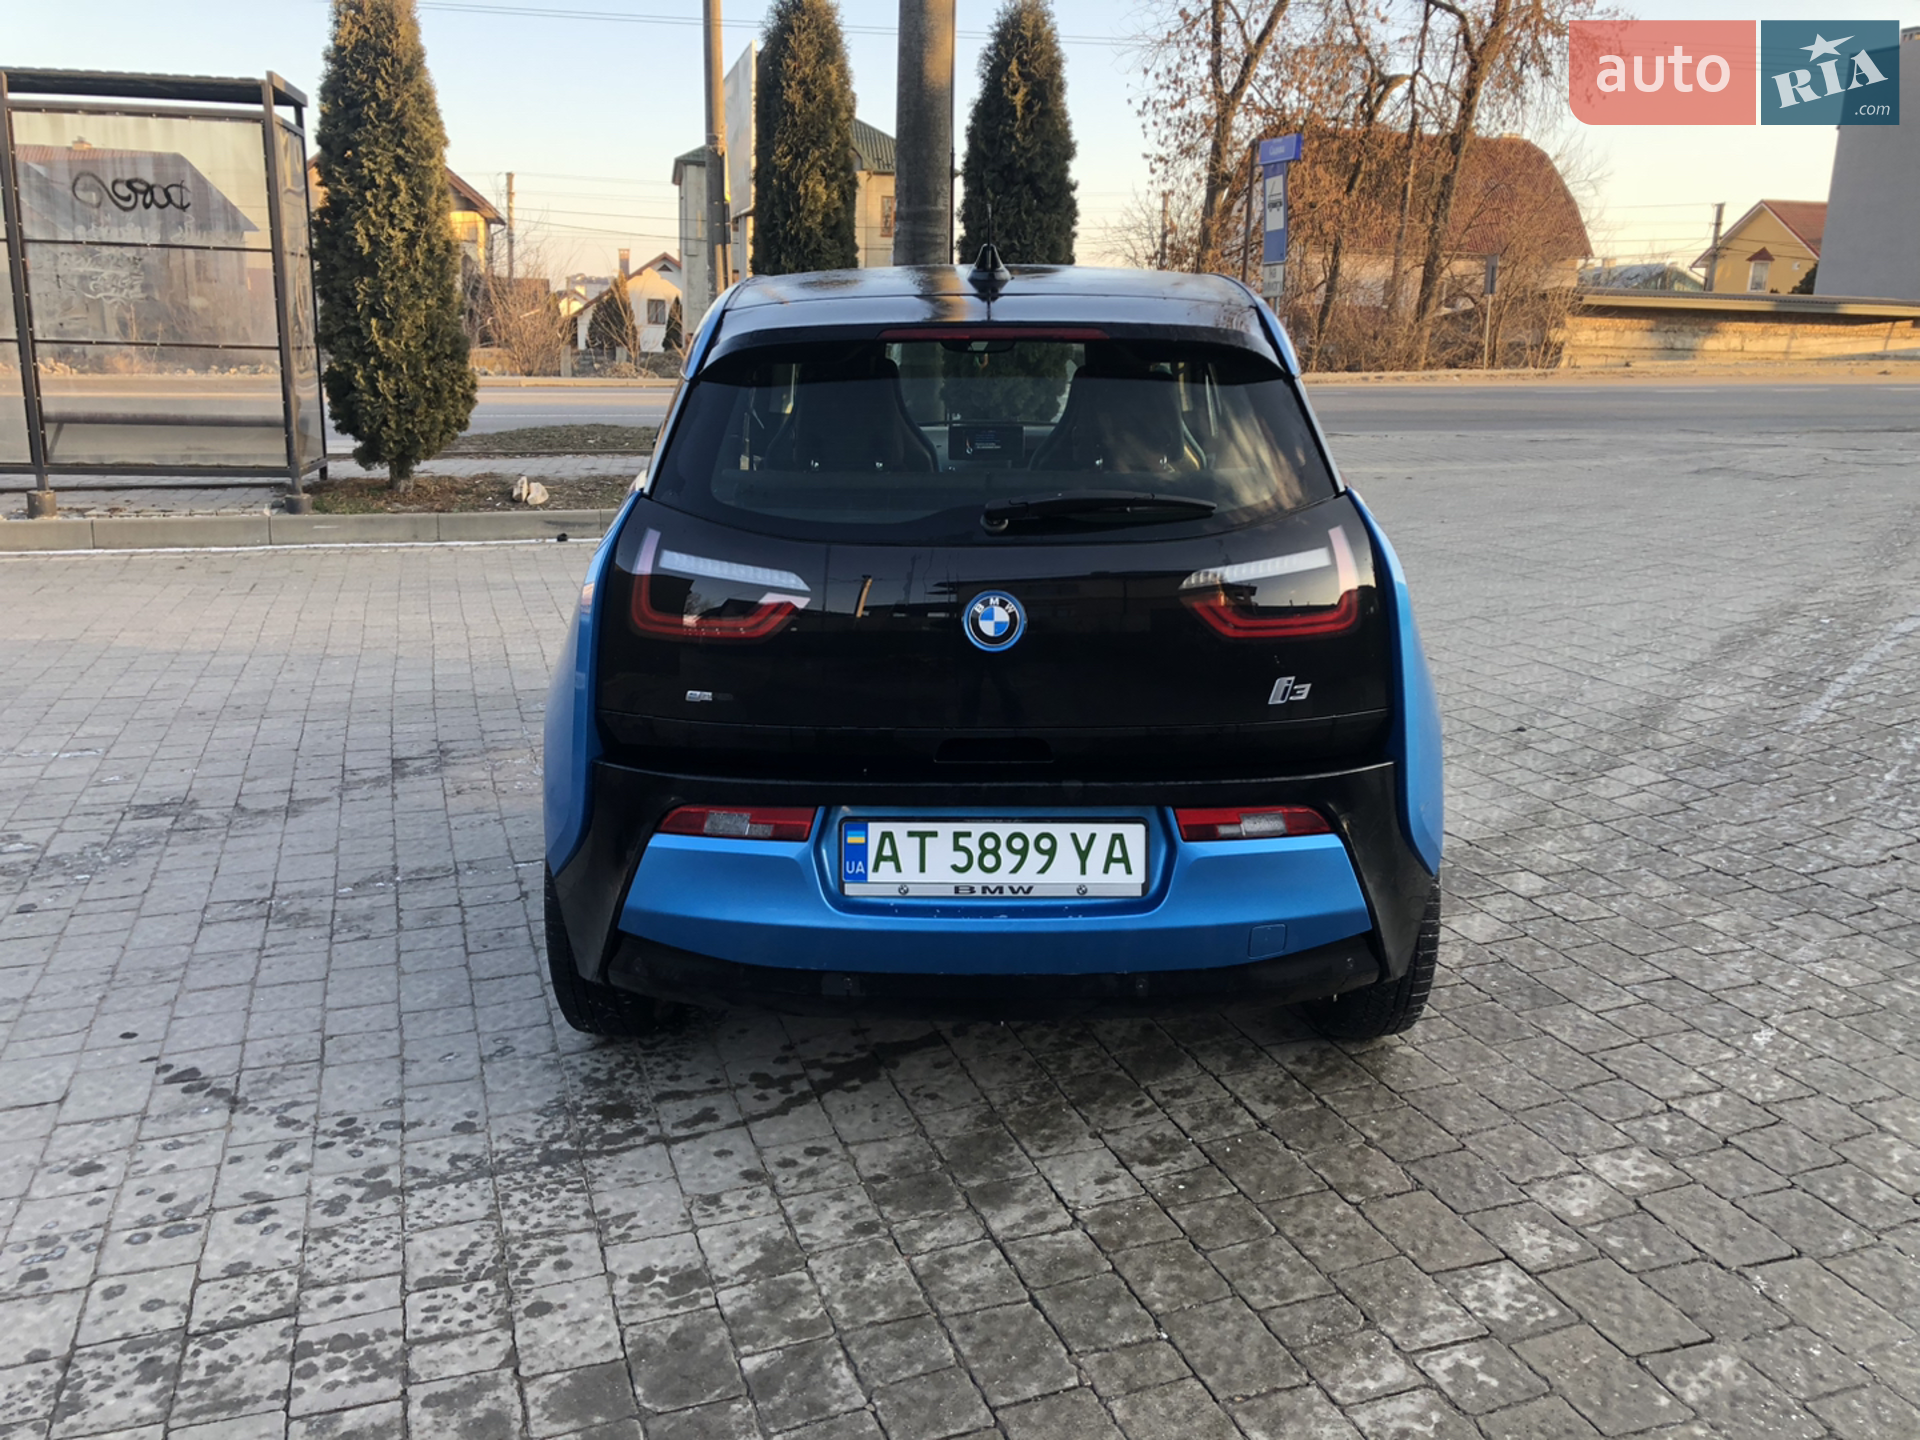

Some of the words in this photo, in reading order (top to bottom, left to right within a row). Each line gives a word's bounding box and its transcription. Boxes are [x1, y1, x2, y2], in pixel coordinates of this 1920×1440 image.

[974, 597, 1016, 613] BMW
[1268, 676, 1312, 704] i3
[872, 831, 938, 873] AT
[950, 831, 1057, 874] 5899
[1070, 832, 1132, 875] YA
[846, 860, 865, 874] UA
[954, 885, 1034, 895] BMW
